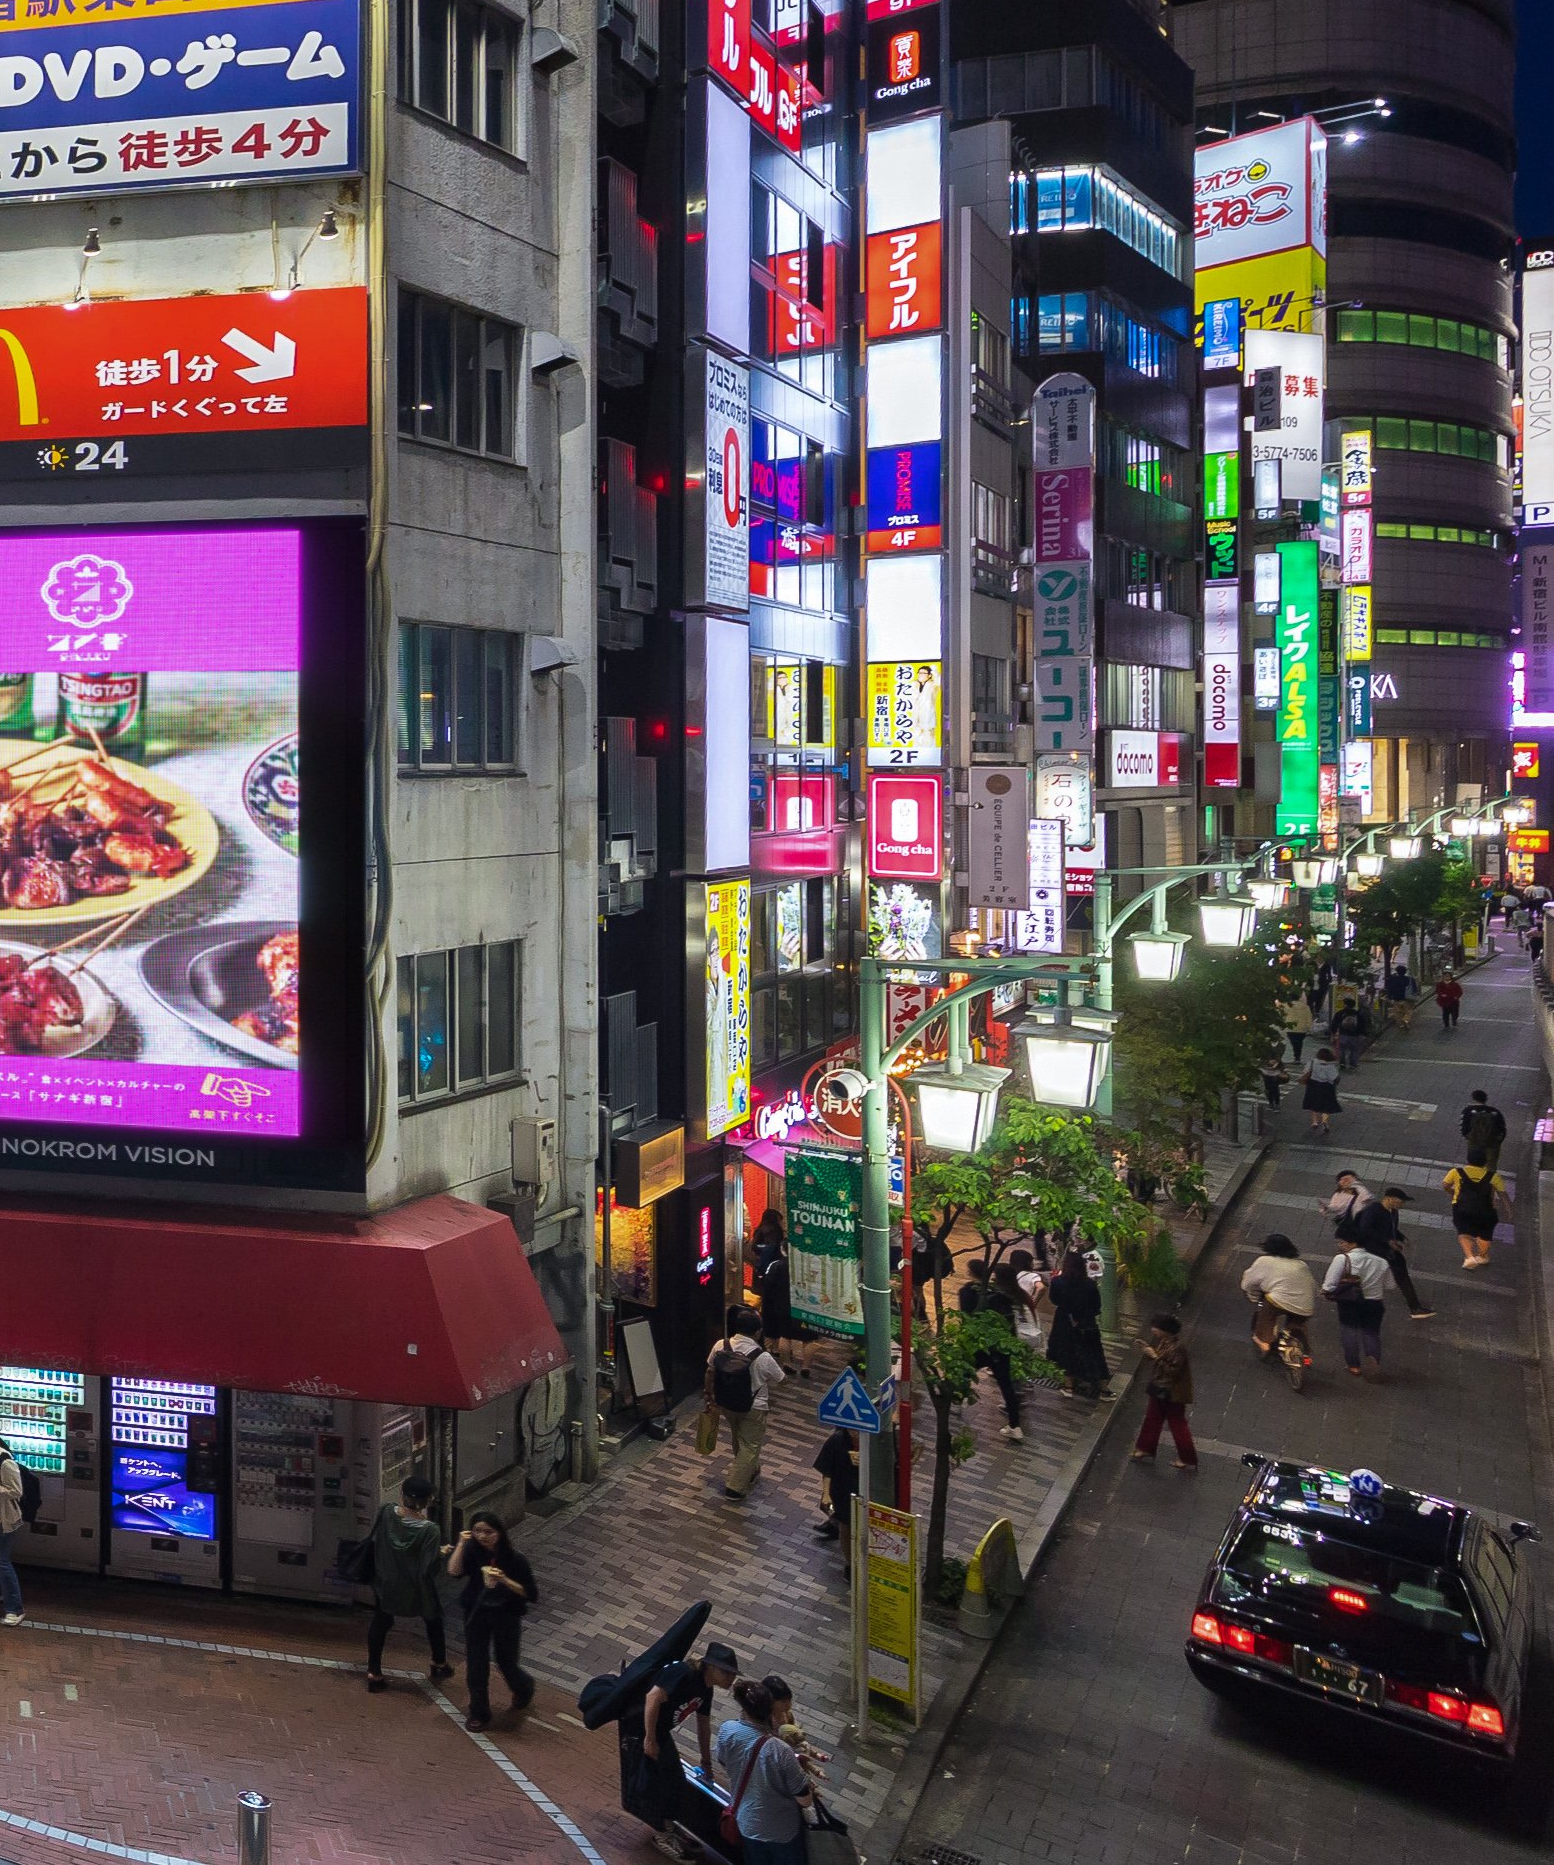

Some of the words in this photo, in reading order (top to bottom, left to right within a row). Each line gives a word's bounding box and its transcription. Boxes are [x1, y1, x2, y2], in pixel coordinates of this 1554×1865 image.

[876, 80, 907, 100] Gong
[910, 75, 932, 90] cha
[890, 231, 920, 331] アイフル
[94, 349, 219, 387] 徒歩1分
[1213, 356, 1230, 367] 7F
[1283, 374, 1319, 398] 募集
[100, 393, 288, 422] ガードくぐって左
[73, 440, 129, 471] 24
[1252, 445, 1318, 462] 3-5774-7506
[896, 452, 913, 511] PROMISE
[887, 514, 921, 526] プロミス
[1042, 473, 1070, 558] Serina
[891, 528, 917, 547] 4F
[896, 666, 914, 747] おたからや
[1212, 663, 1226, 732] docomo
[888, 750, 919, 765] 2F
[1116, 742, 1154, 775] docomo
[877, 842, 906, 855] Gong
[908, 842, 933, 855] cha
[1024, 910, 1041, 947] 大江戸
[123, 1142, 216, 1167] VISION
[789, 1209, 856, 1233] TOUNAN
[796, 1200, 849, 1218] SHINJUKU
[124, 1492, 177, 1511] KENT
